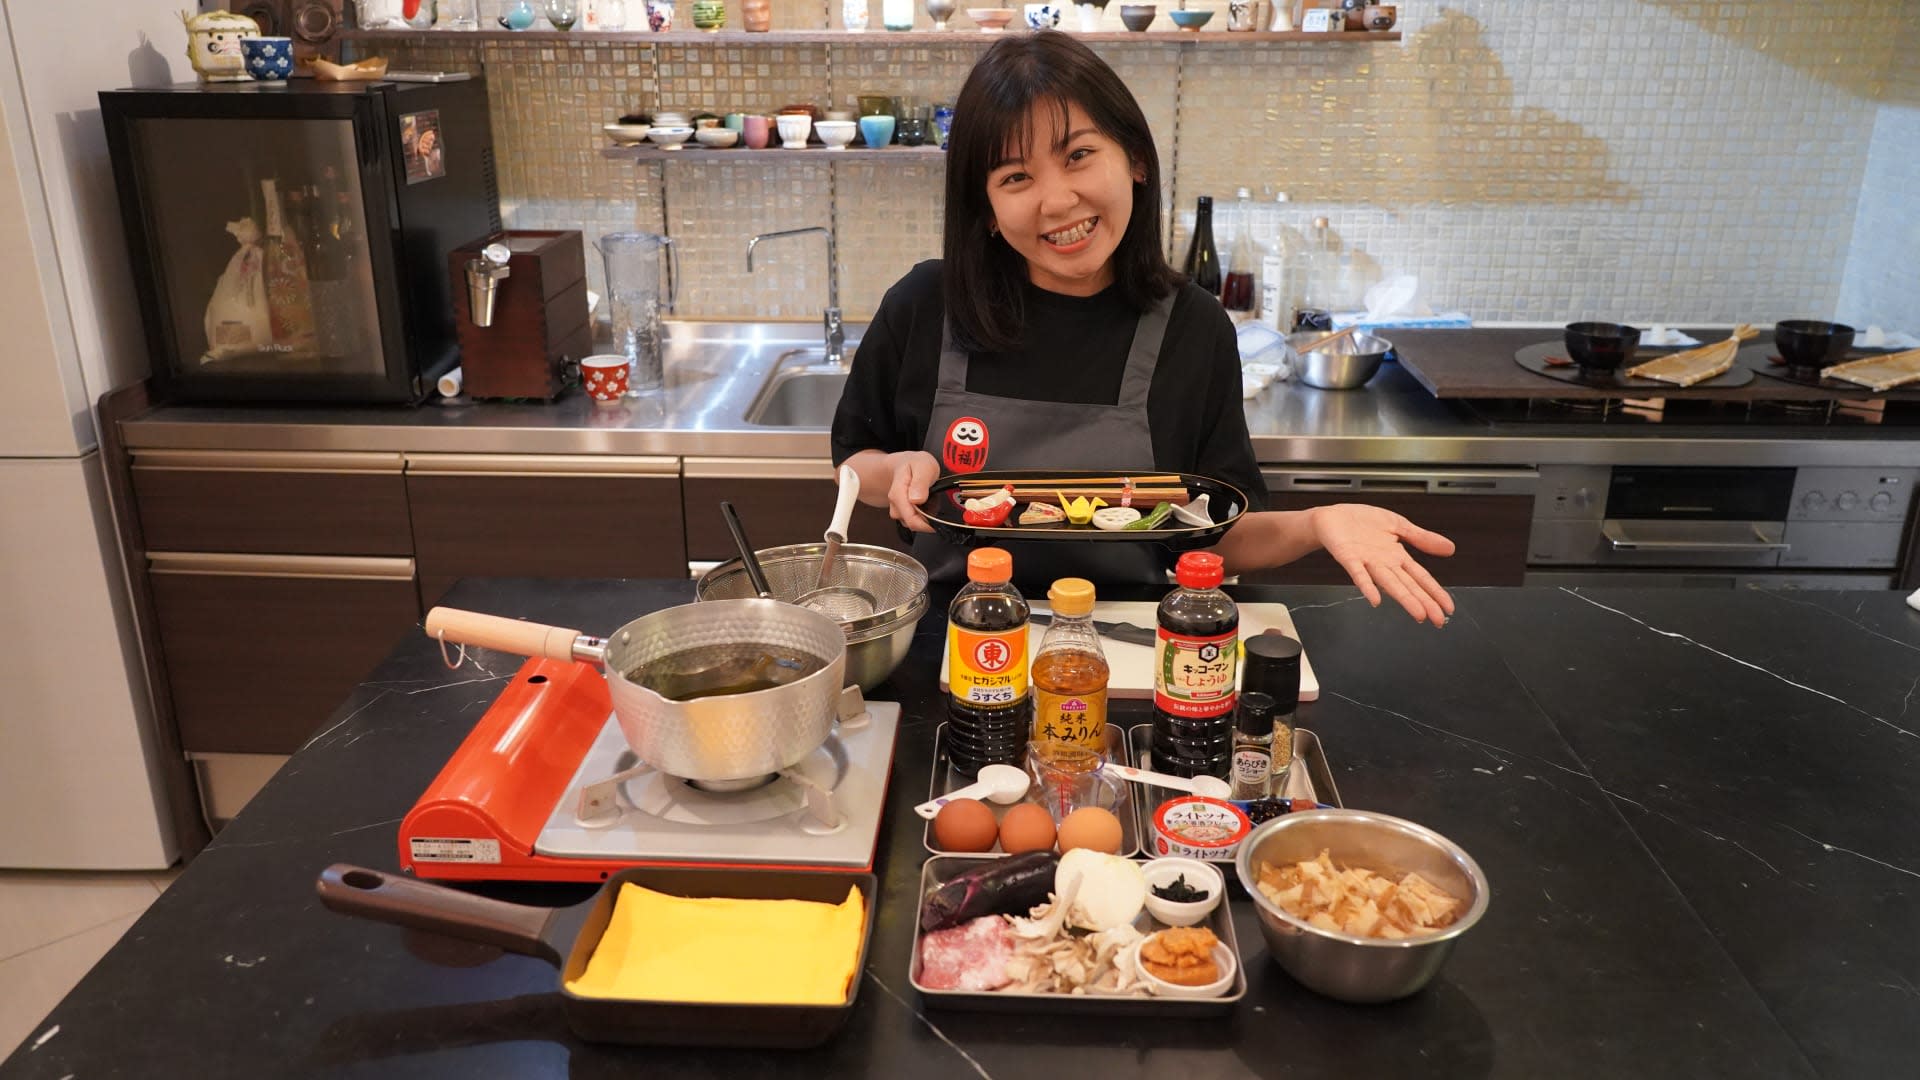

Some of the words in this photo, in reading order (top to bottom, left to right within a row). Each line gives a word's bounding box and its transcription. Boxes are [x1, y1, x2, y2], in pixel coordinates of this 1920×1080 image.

[982, 642, 1004, 668] 東
[1183, 663, 1229, 674] キッコーマン
[973, 675, 1011, 690] ヒガシマル
[1186, 673, 1227, 687] しょうゆ
[972, 692, 1012, 702] うすくち
[1060, 713, 1087, 725] 純米
[1042, 722, 1102, 742] 本みりん
[1236, 757, 1267, 768] あらびき
[1239, 767, 1265, 775] コショー
[1172, 812, 1229, 820] ライトツナ
[1183, 848, 1229, 859] ライトツナ
